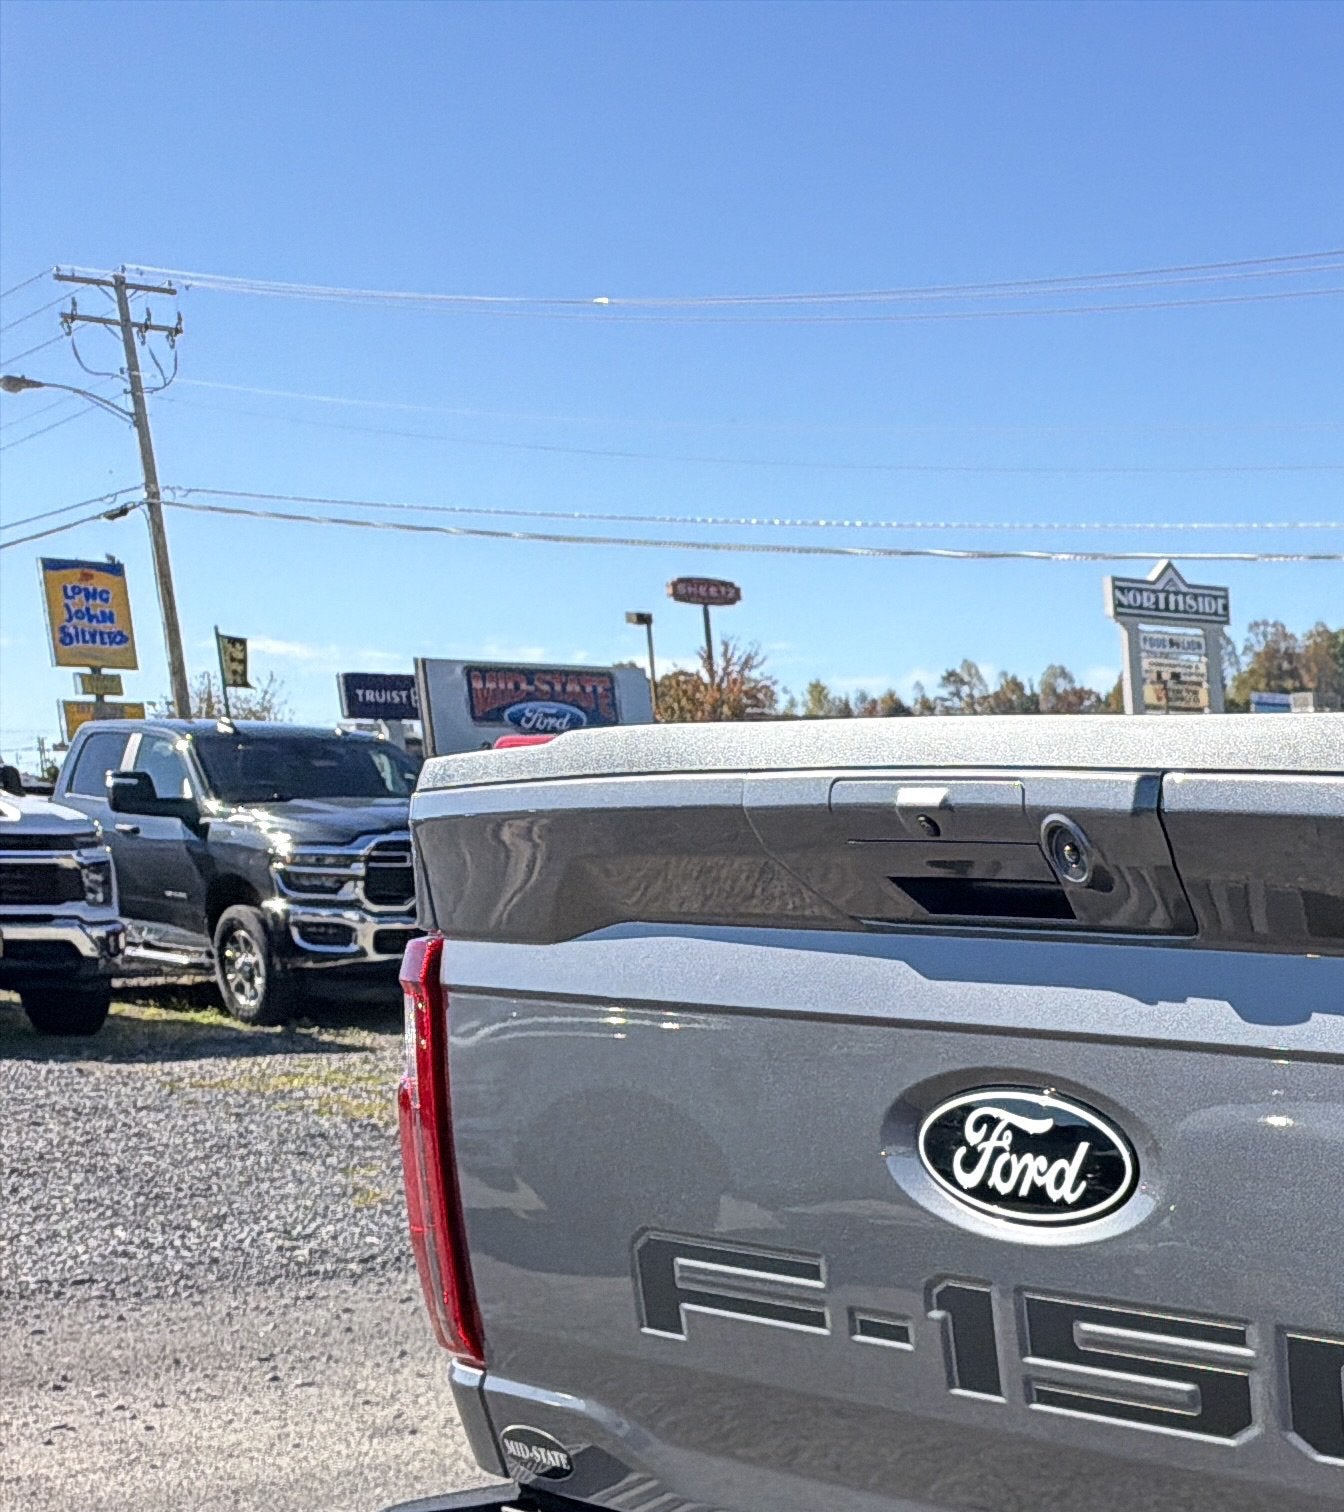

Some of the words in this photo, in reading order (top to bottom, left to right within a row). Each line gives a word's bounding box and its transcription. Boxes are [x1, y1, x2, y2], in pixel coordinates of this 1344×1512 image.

[1114, 588, 1228, 615] NORTHSIDE
[355, 689, 409, 705] TRUIST
[471, 671, 615, 719] MID-STATE
[520, 707, 570, 730] Ford
[952, 1106, 1091, 1205] Ford
[503, 1438, 571, 1471] MID-STATE
